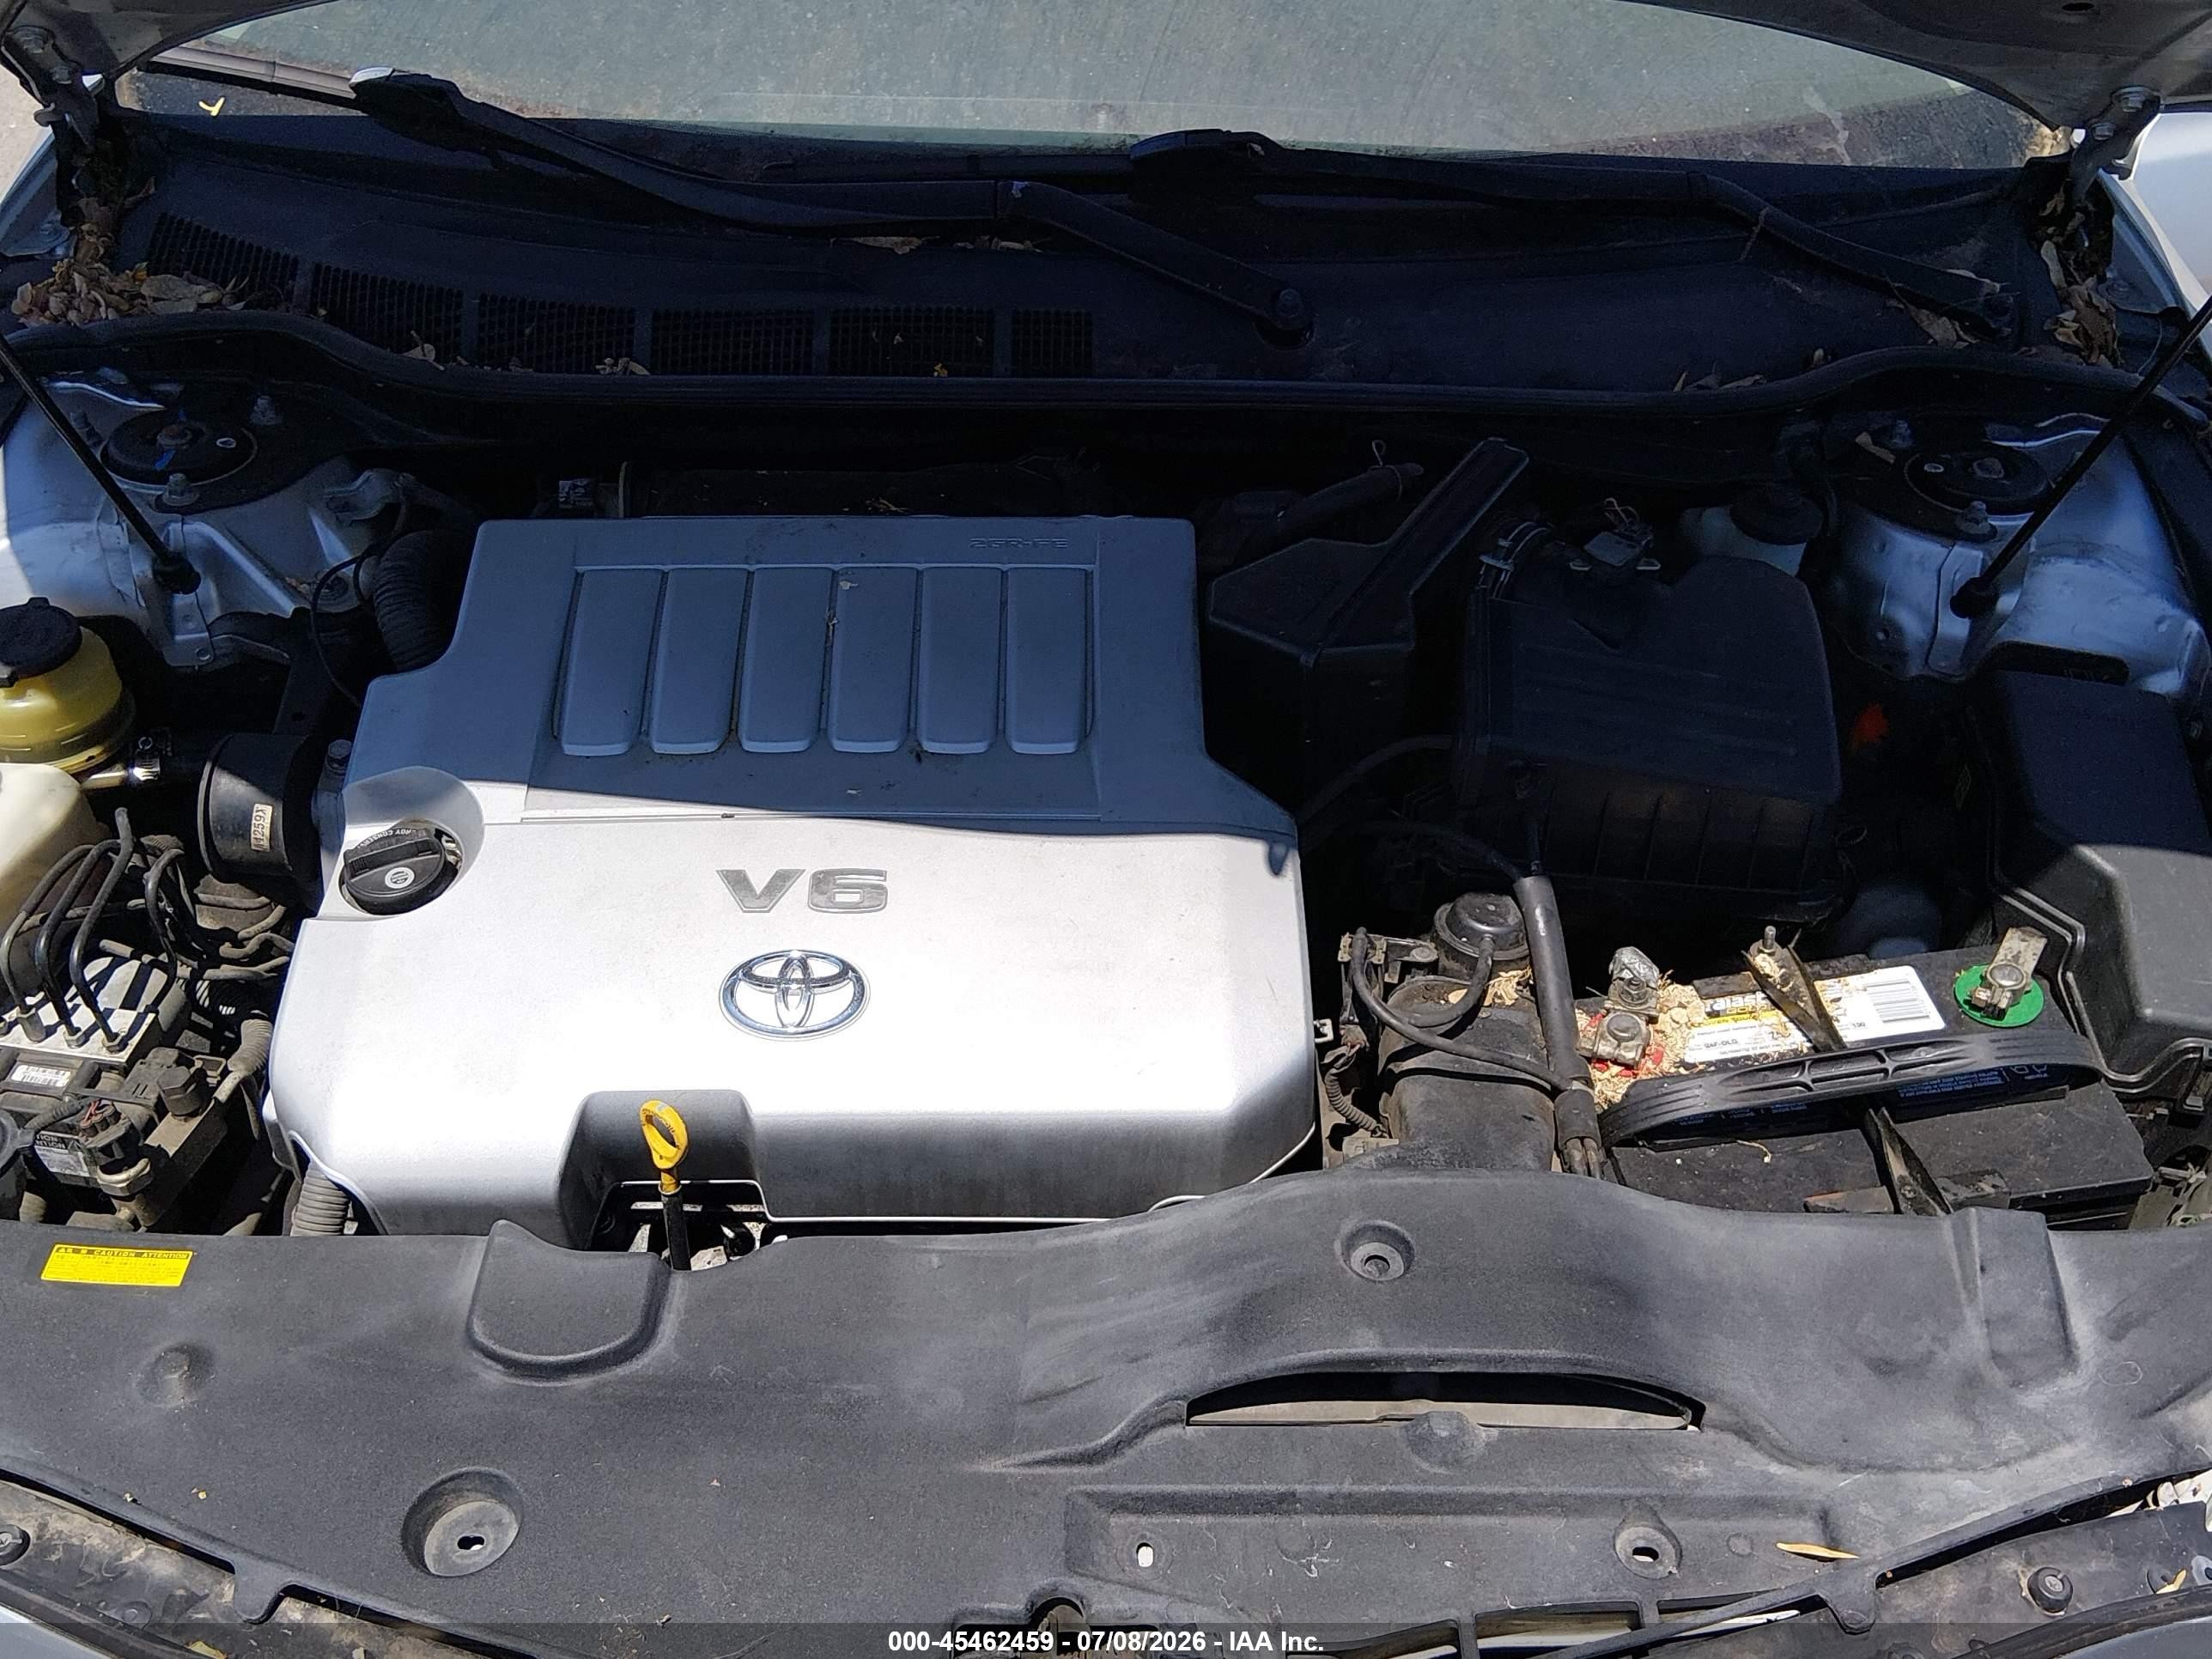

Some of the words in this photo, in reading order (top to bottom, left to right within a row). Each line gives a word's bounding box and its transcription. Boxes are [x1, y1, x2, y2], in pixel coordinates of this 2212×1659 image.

[715, 867, 889, 914] V6
[94, 1249, 136, 1258] CAUTION
[143, 1251, 188, 1260] ATTENTION
